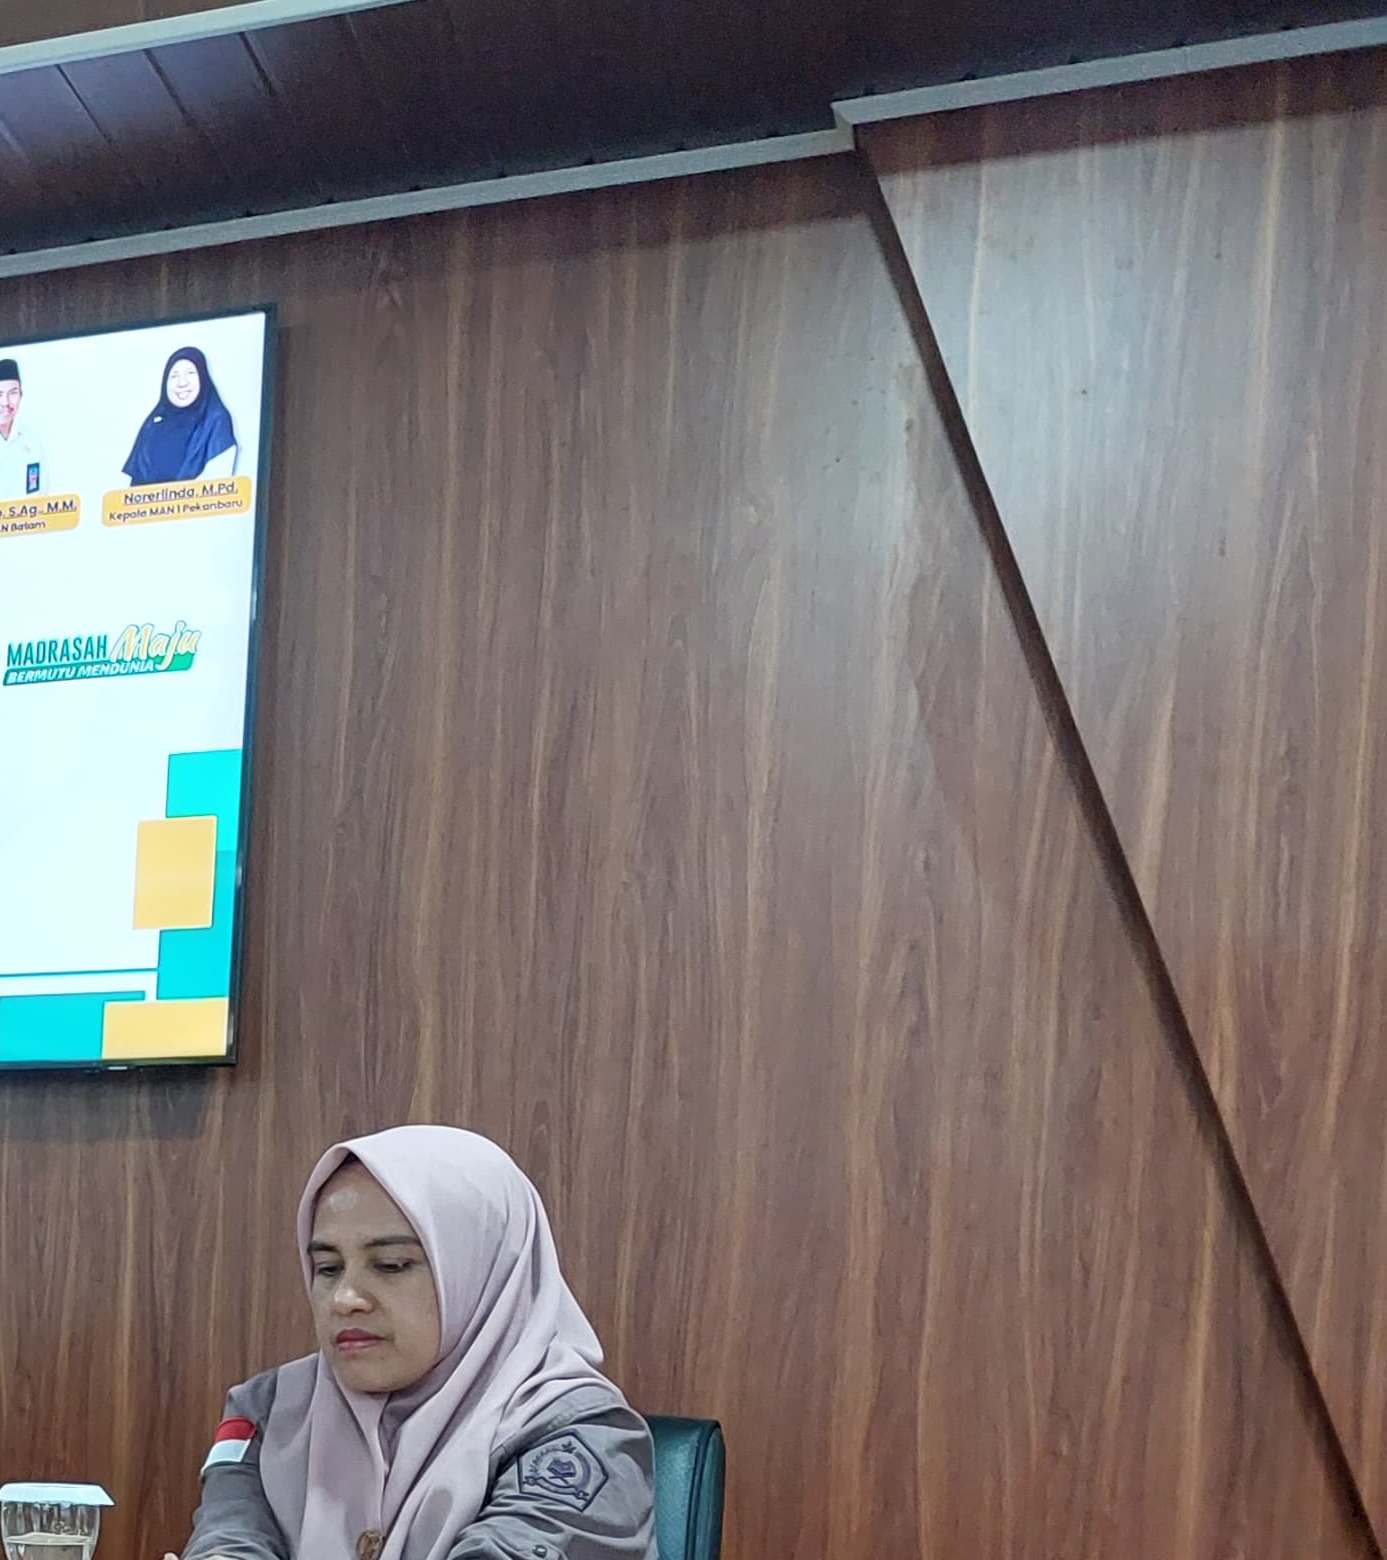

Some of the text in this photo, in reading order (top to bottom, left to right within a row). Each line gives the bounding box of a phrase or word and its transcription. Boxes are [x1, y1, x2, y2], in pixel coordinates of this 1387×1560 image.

[109, 509, 147, 522] Kepala
[149, 506, 175, 517] MAN
[182, 499, 243, 514] Pekanbaru
[10, 521, 46, 533] Batam
[7, 619, 202, 671] MADRASAH Maju
[5, 659, 155, 685] BERMUTU MENDUNIA
